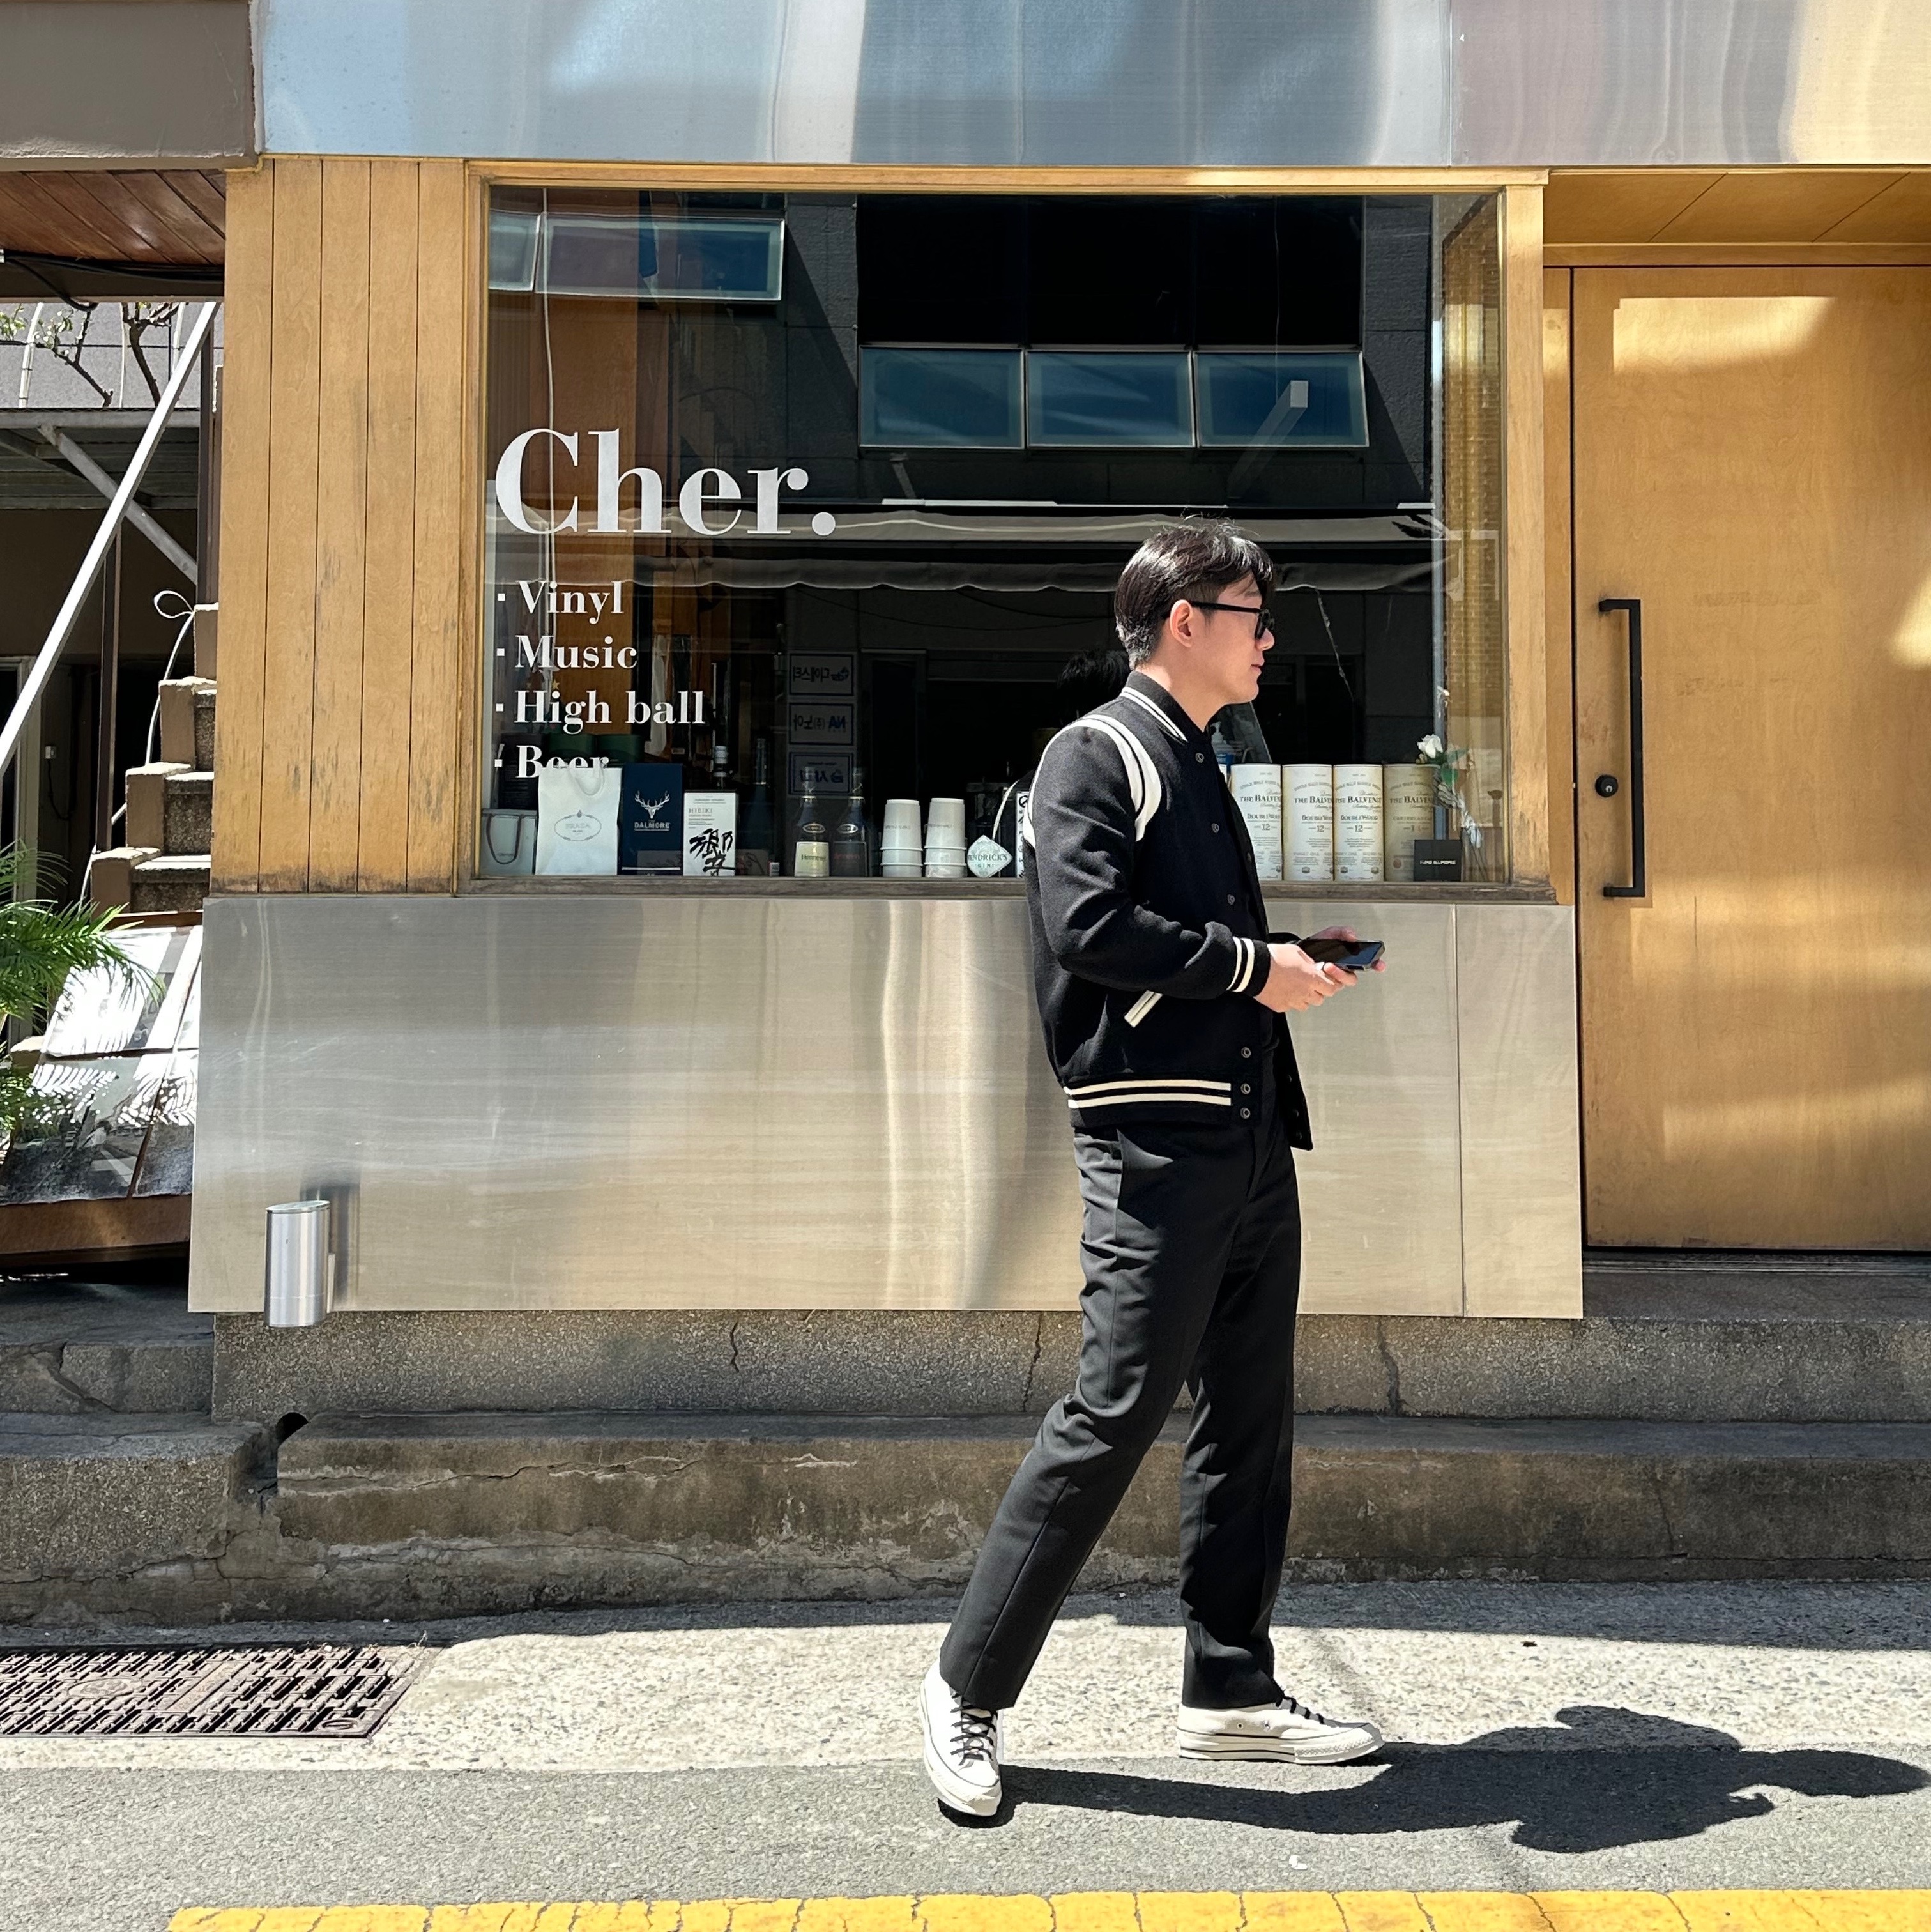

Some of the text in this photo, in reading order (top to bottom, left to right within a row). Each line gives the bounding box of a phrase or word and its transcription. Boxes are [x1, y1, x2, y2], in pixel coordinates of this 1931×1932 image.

[494, 427, 836, 536] Cher.
[515, 579, 624, 625] Vinyl
[514, 634, 638, 670] Music
[514, 689, 706, 735] High ball
